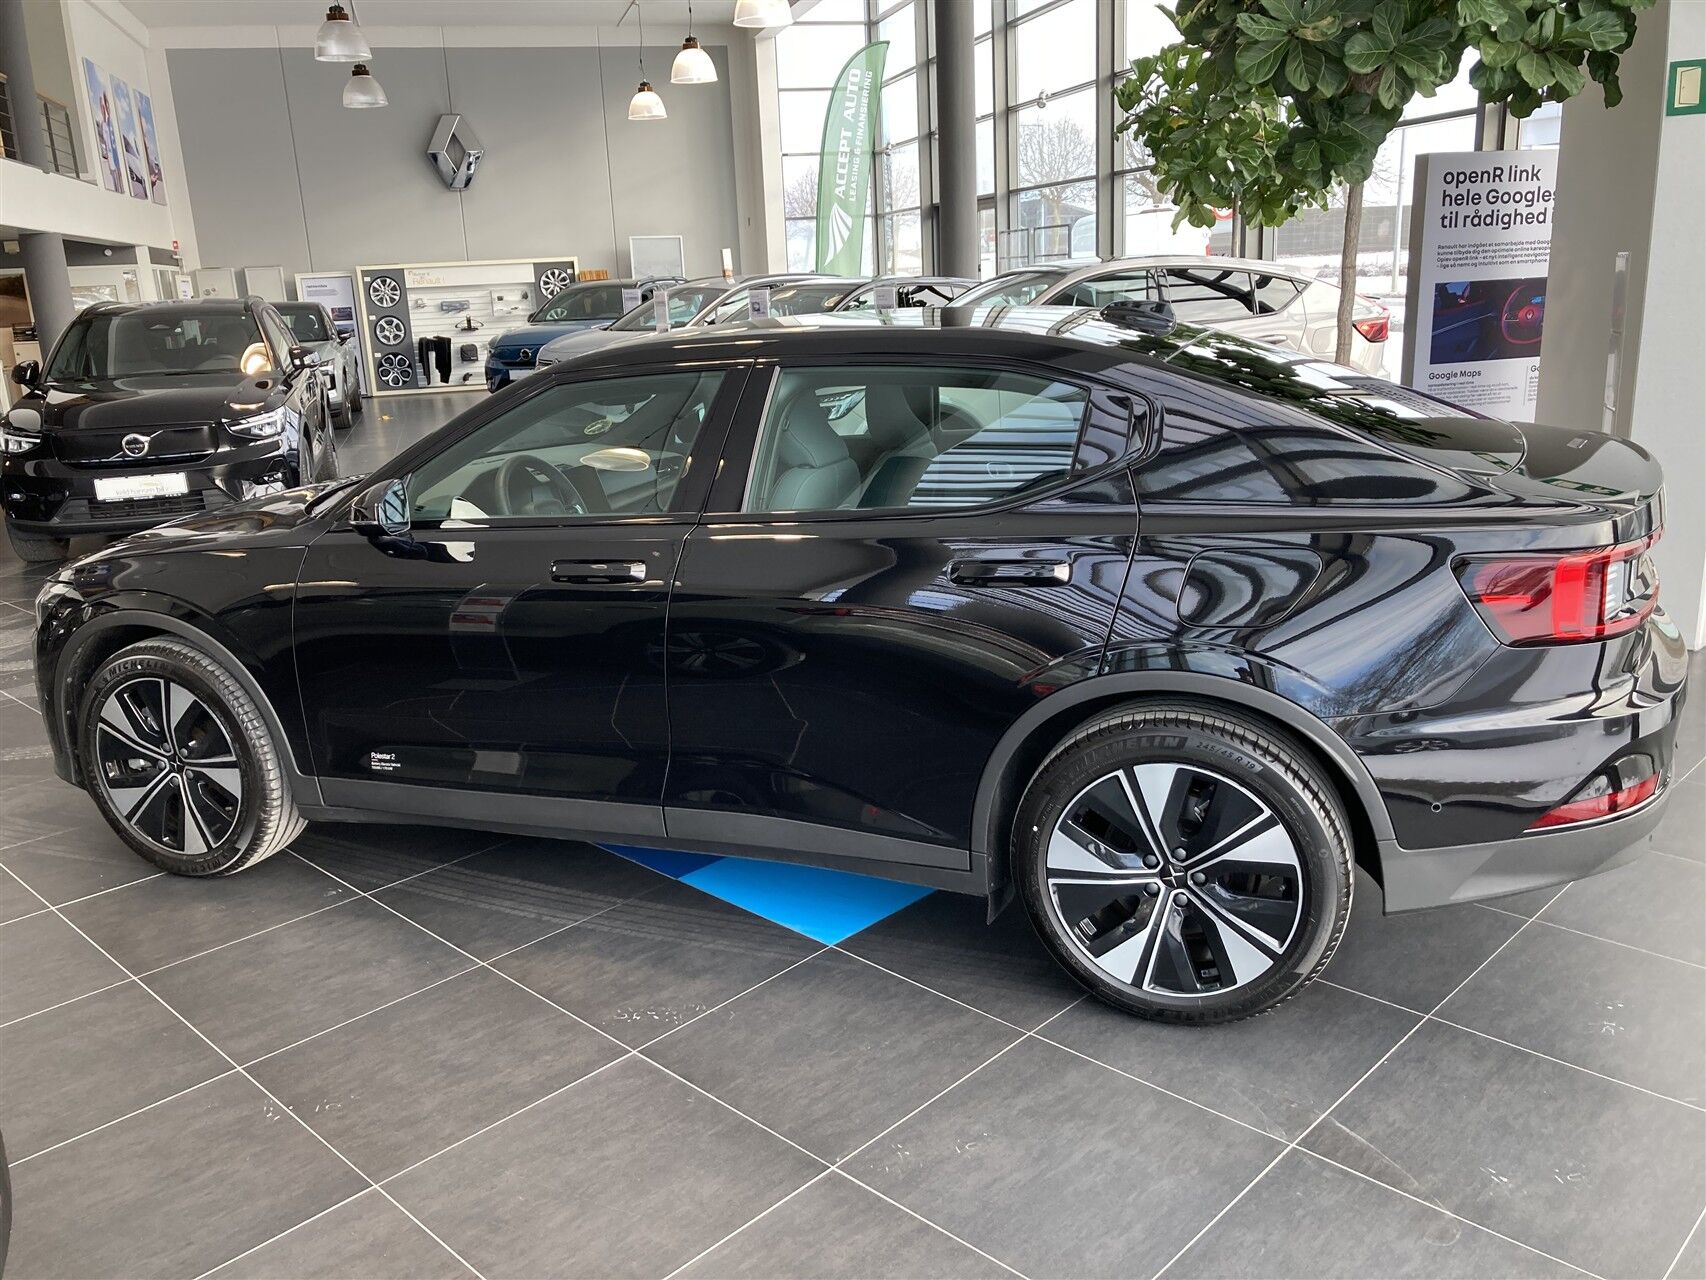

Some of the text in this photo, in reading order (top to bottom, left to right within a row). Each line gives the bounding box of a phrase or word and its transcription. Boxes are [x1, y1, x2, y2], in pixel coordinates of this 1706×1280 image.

[834, 68, 862, 199] ACCEPT AUTO
[849, 70, 873, 202] LEASING & FINANSIERING
[1443, 164, 1542, 189] openR link
[1442, 188, 1482, 207] hele
[1440, 207, 1547, 230] til rådighed
[1428, 370, 1482, 380] Google Maps
[1234, 755, 1243, 763] R
